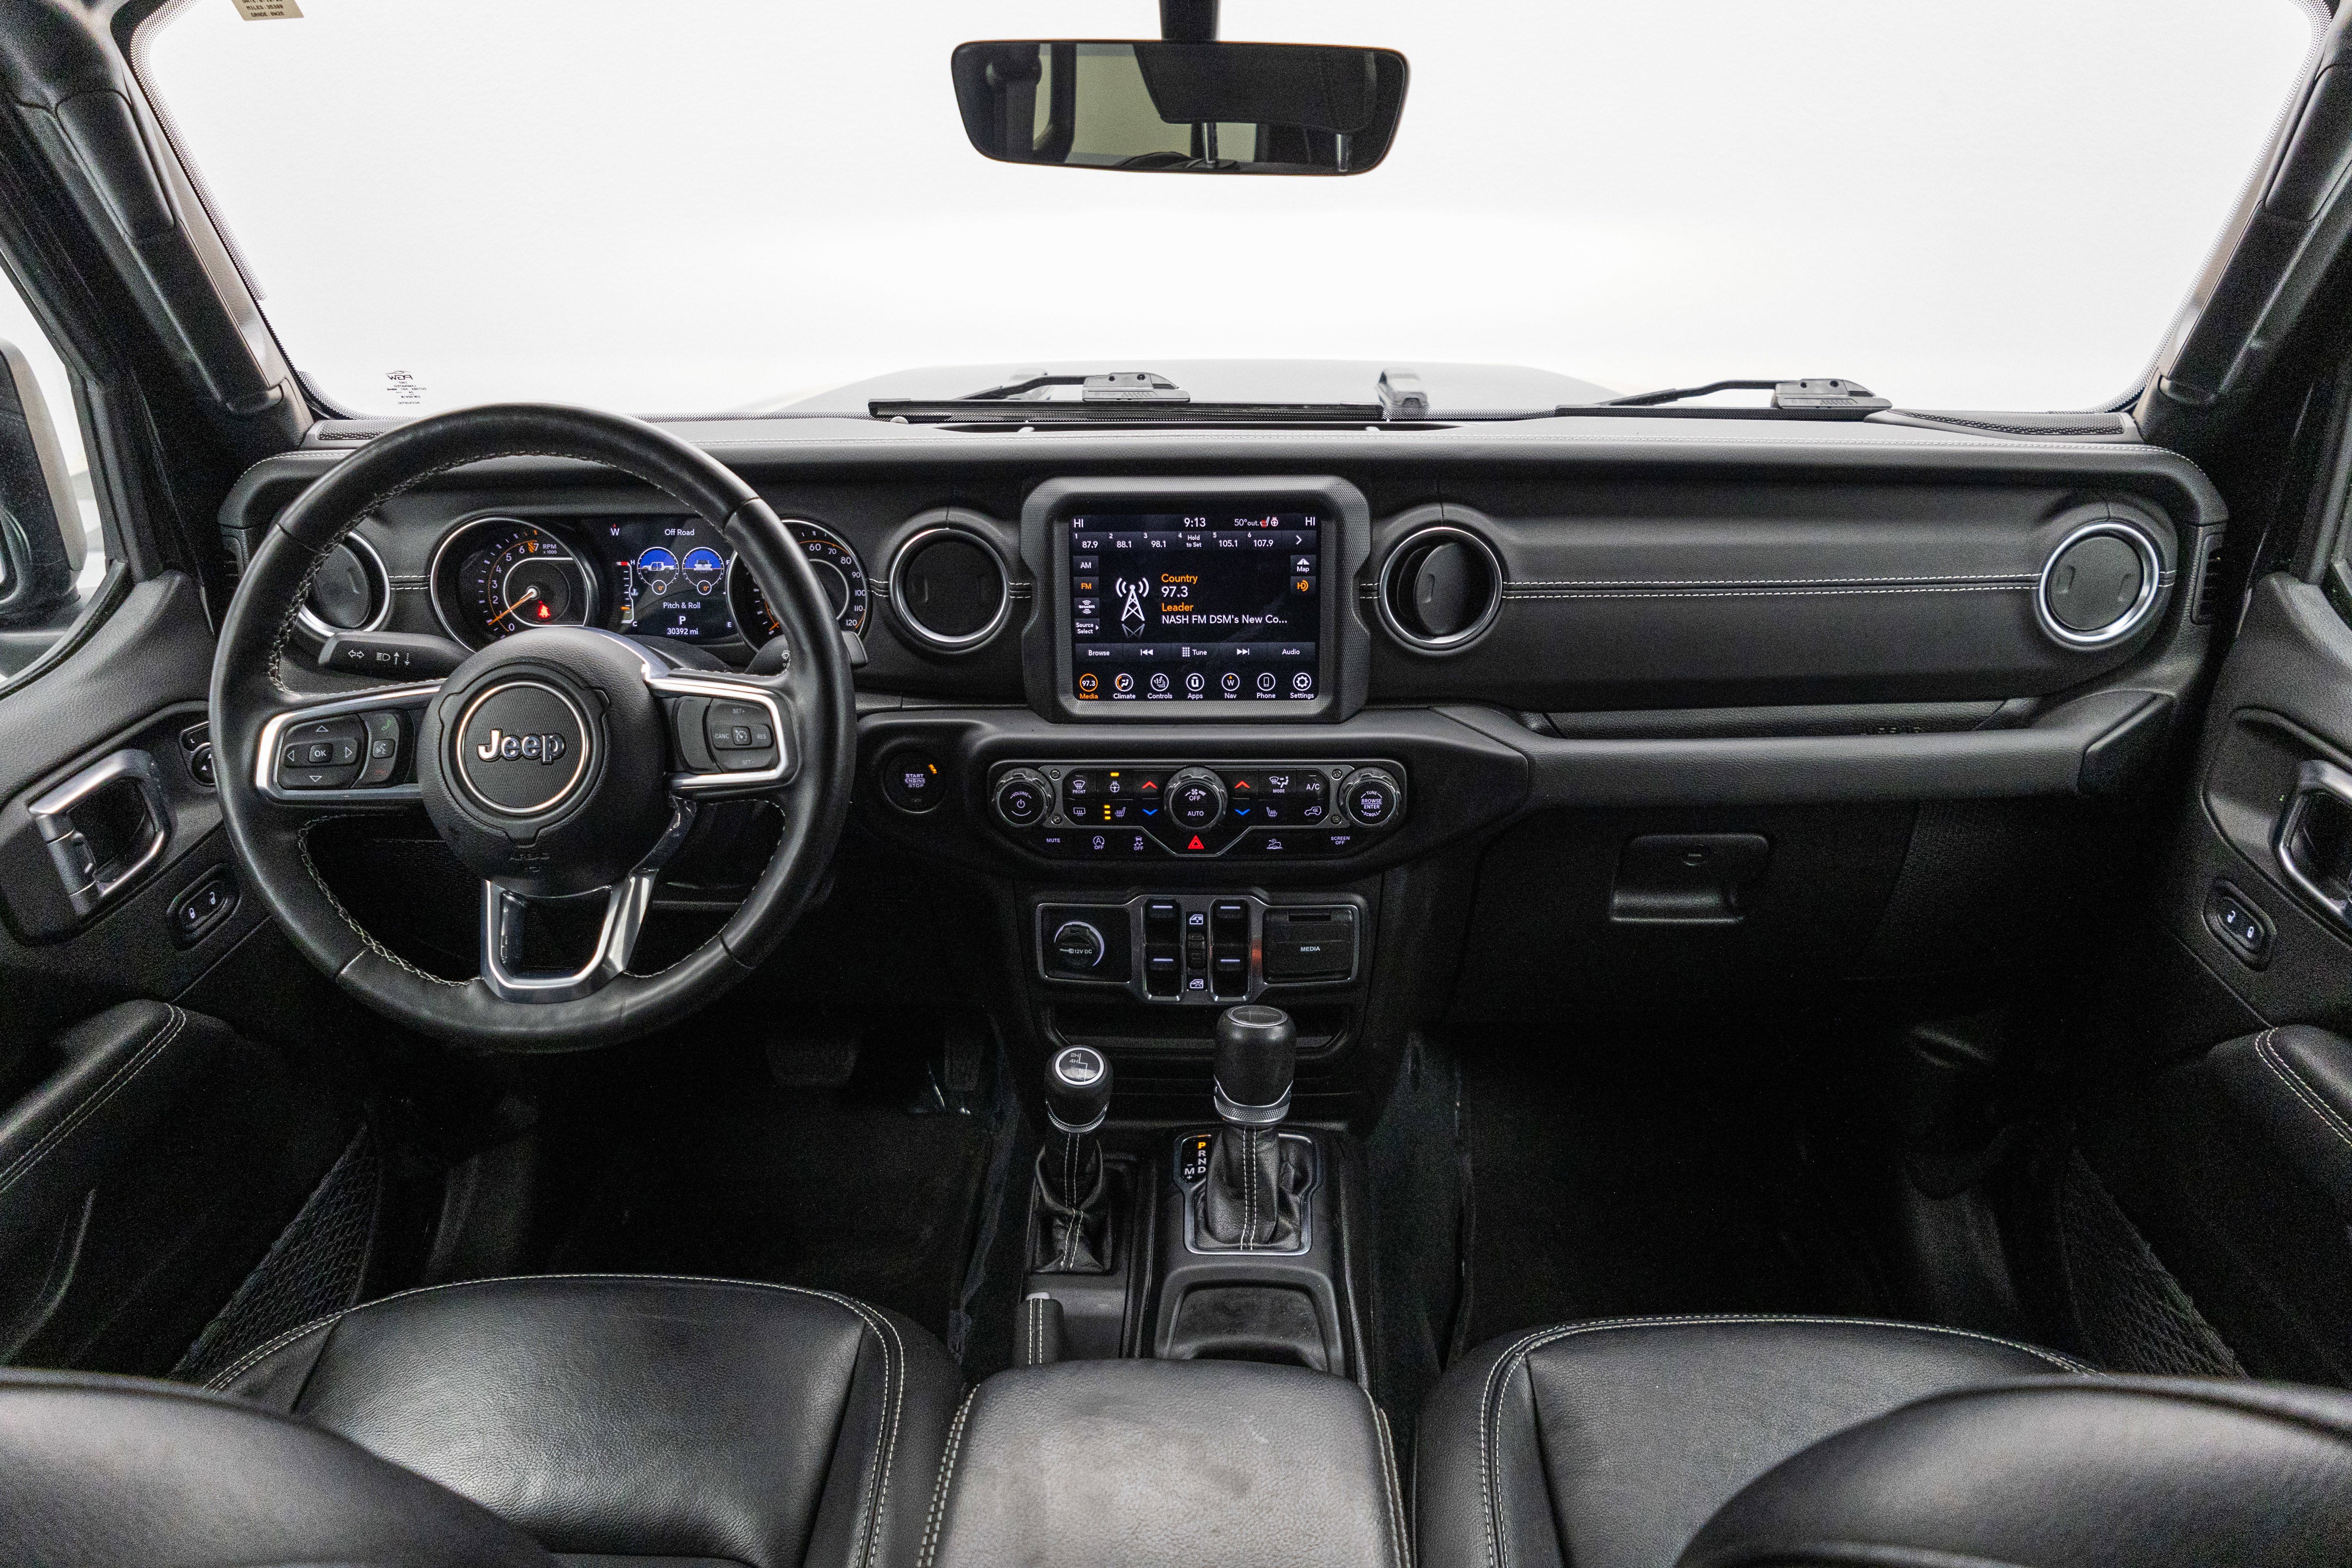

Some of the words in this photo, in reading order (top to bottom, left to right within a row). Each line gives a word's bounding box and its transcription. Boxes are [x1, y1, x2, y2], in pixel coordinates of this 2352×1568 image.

[1074, 519, 1084, 528] HI
[1184, 517, 1205, 527] 9:13
[1305, 517, 1315, 526] HI
[496, 565, 501, 573] 4
[1161, 574, 1198, 584] Country
[492, 580, 498, 588] 3
[1162, 586, 1188, 597] 97.3
[492, 595, 498, 604] 2
[1162, 602, 1194, 612] Leader
[679, 616, 686, 625] P
[1162, 615, 1189, 624] NASH
[1192, 615, 1206, 624] FM
[1209, 615, 1239, 624] DSM's
[1242, 615, 1263, 624] New
[478, 730, 565, 764] Jeep
